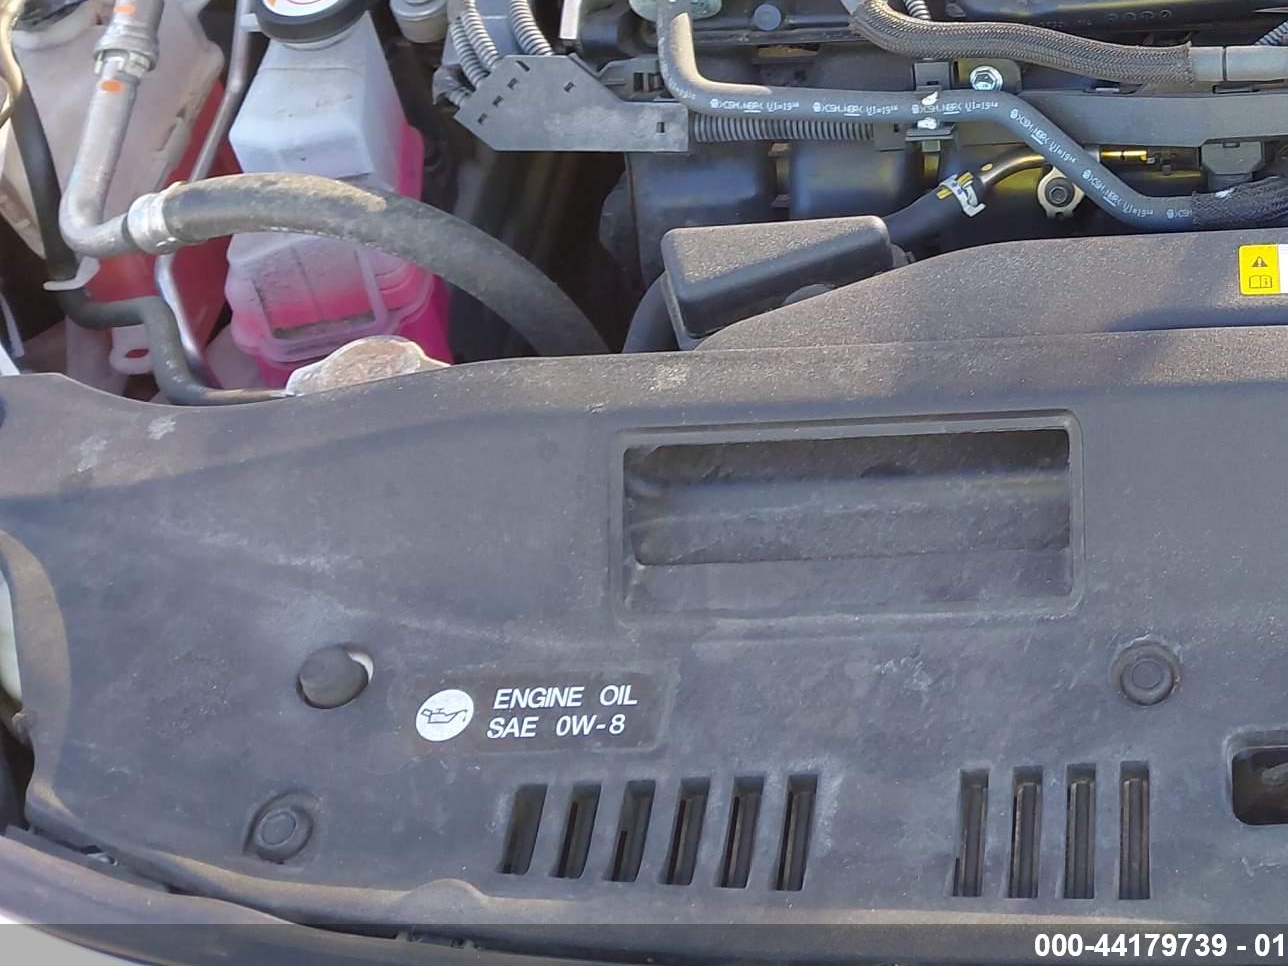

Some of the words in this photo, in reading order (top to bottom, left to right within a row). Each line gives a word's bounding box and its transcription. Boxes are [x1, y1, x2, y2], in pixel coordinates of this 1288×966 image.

[493, 686, 585, 710] ENGINE
[599, 684, 638, 706] OIL
[486, 716, 540, 739] SAE
[556, 713, 626, 737] 0W-8
